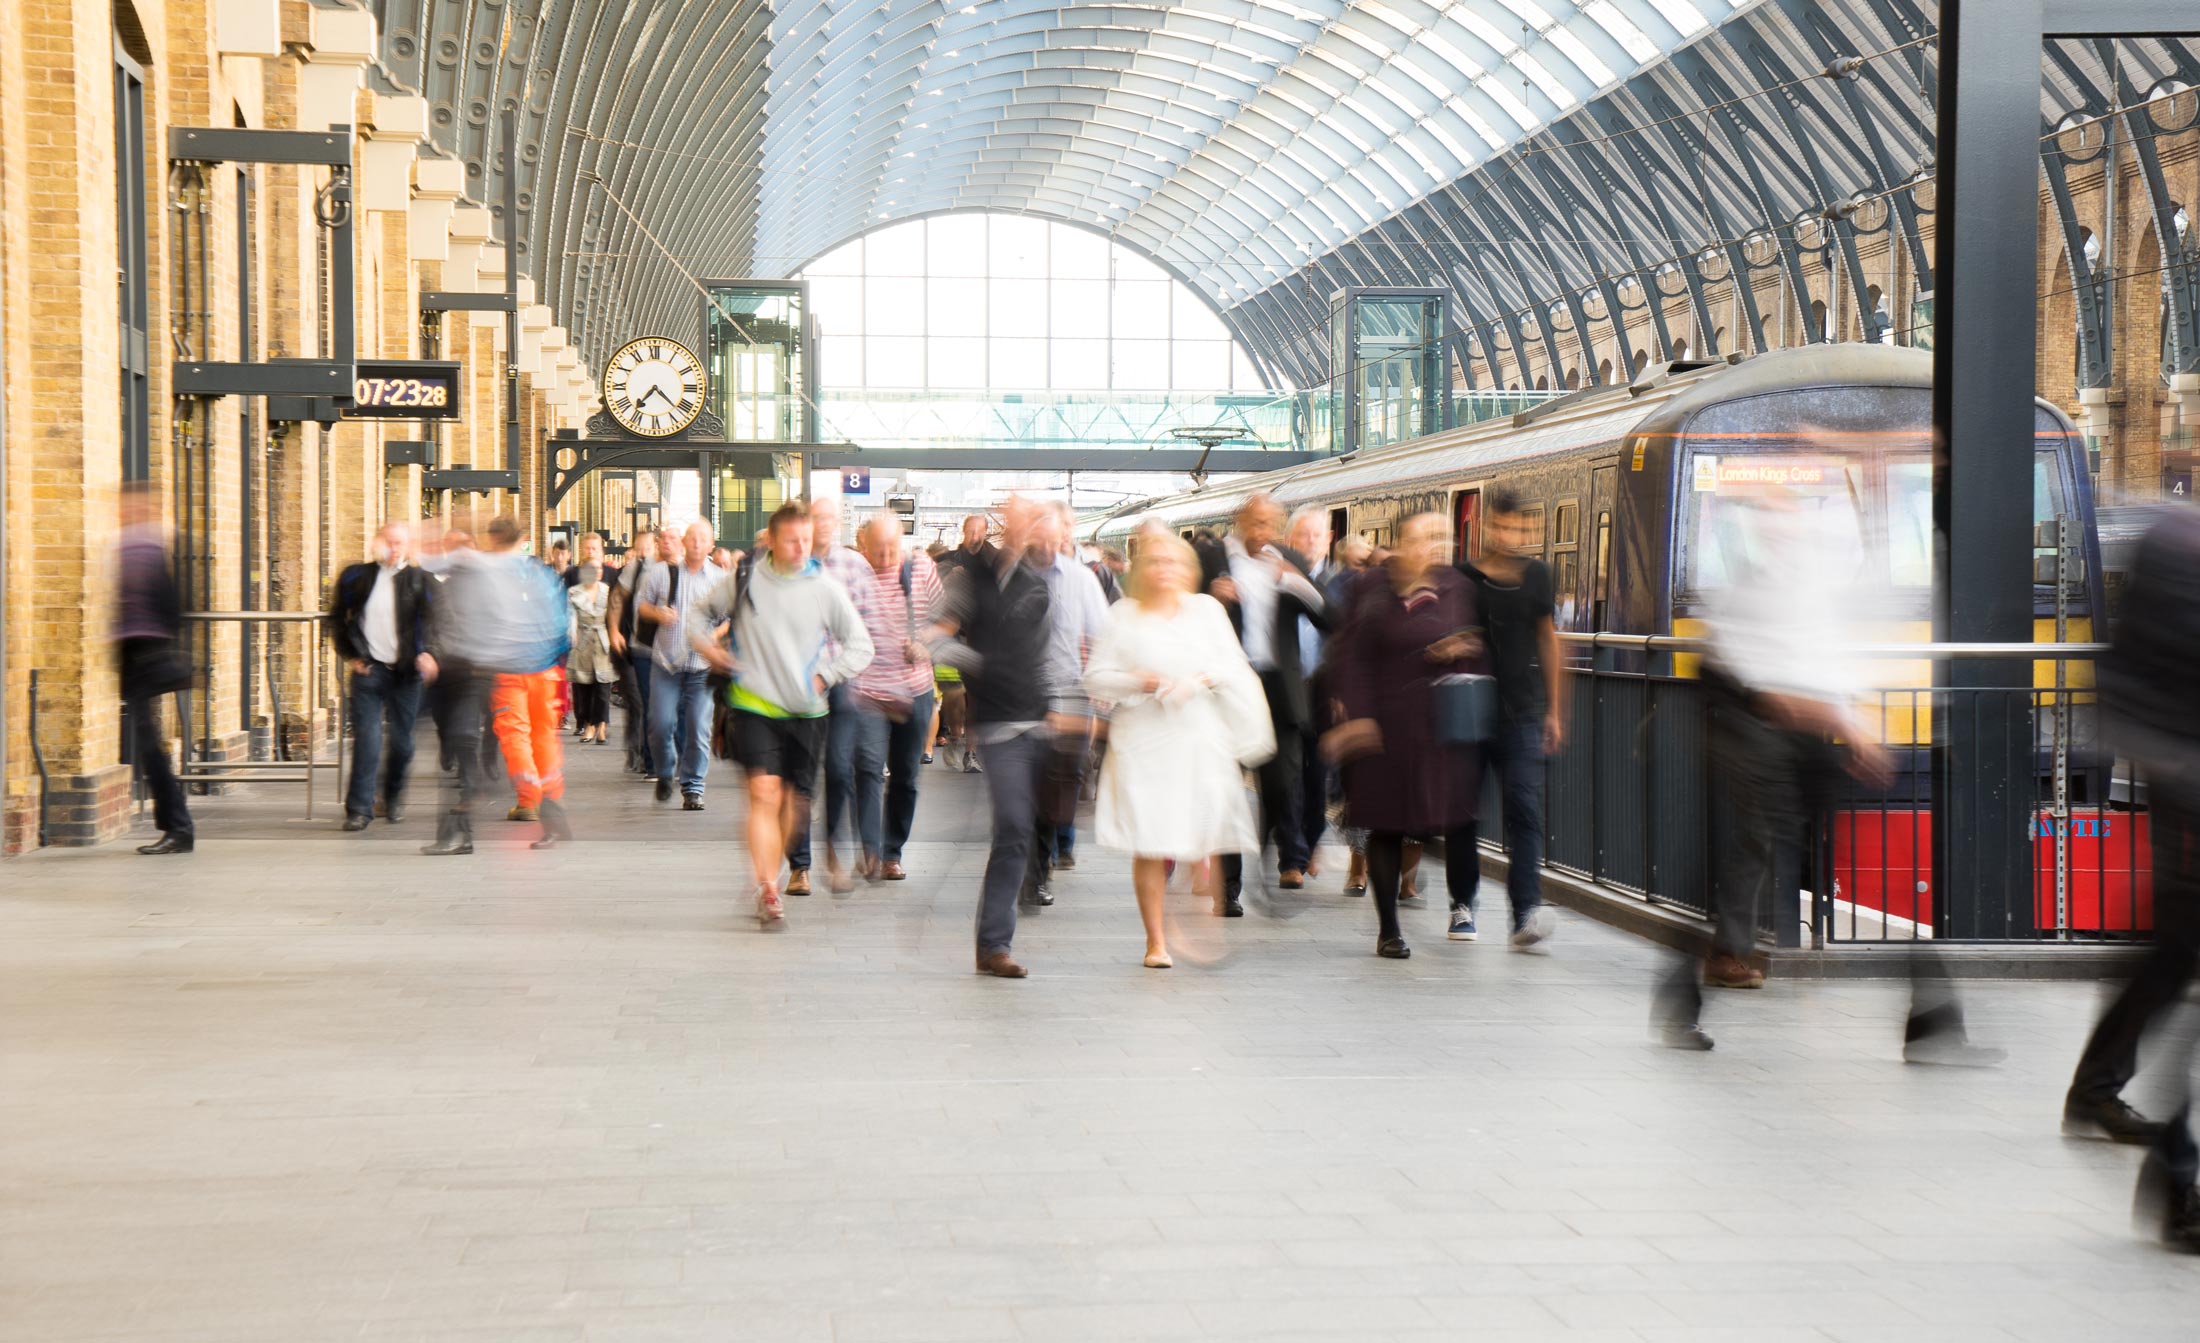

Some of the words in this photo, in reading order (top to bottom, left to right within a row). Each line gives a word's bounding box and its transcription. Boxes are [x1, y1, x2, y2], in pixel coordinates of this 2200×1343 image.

[849, 472, 860, 488] 8
[1719, 466, 1758, 481] London
[1760, 466, 1787, 484] Kings
[1790, 466, 1820, 481] Cross
[2172, 481, 2184, 496] 4
